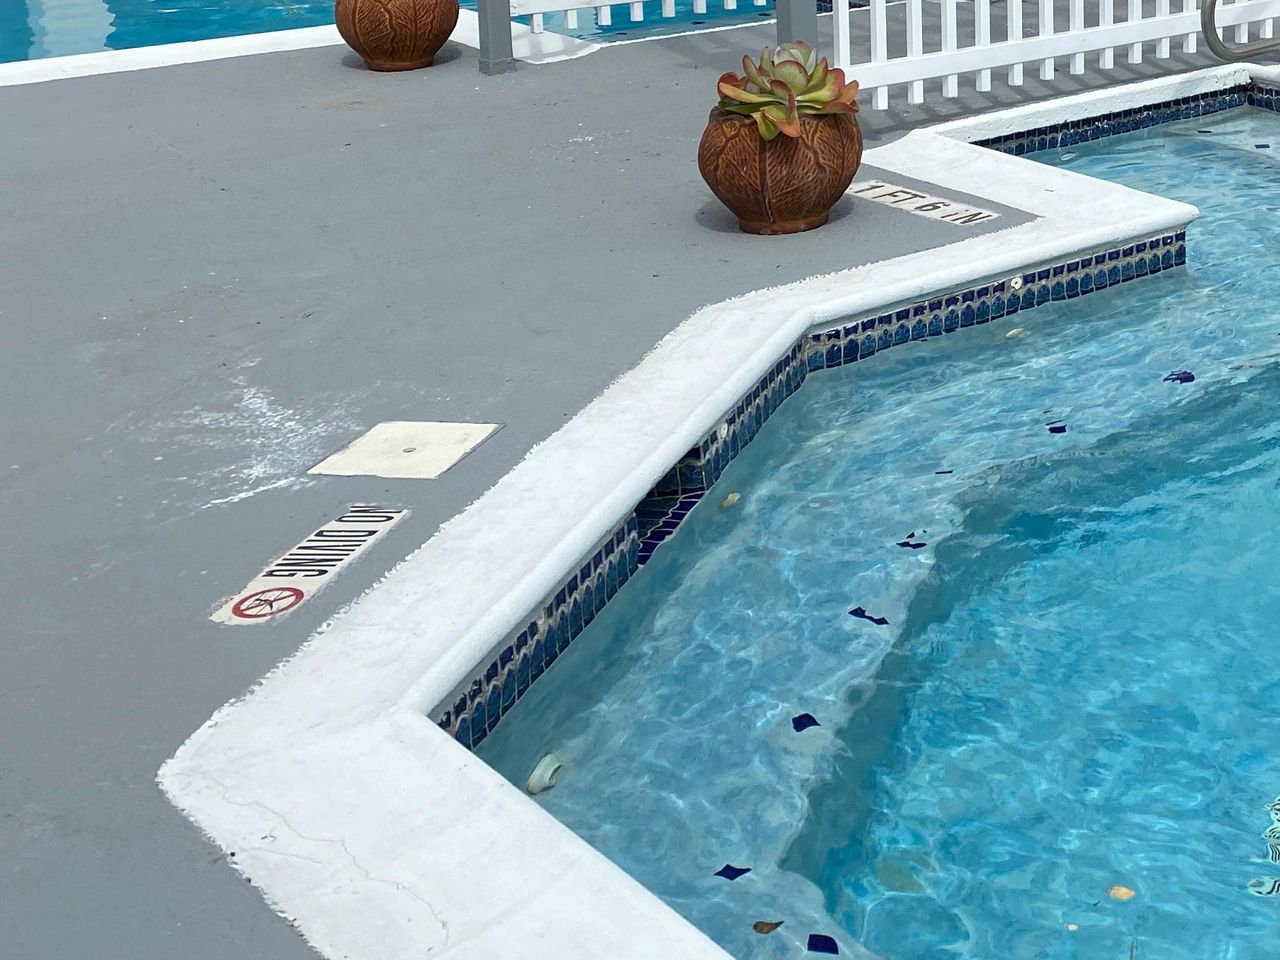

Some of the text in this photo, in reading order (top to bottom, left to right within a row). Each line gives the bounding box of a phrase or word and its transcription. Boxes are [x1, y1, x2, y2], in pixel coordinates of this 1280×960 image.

[854, 184, 885, 194] 1
[872, 189, 927, 204] FT
[914, 201, 951, 212] 6
[261, 505, 403, 578] NO DIVING
